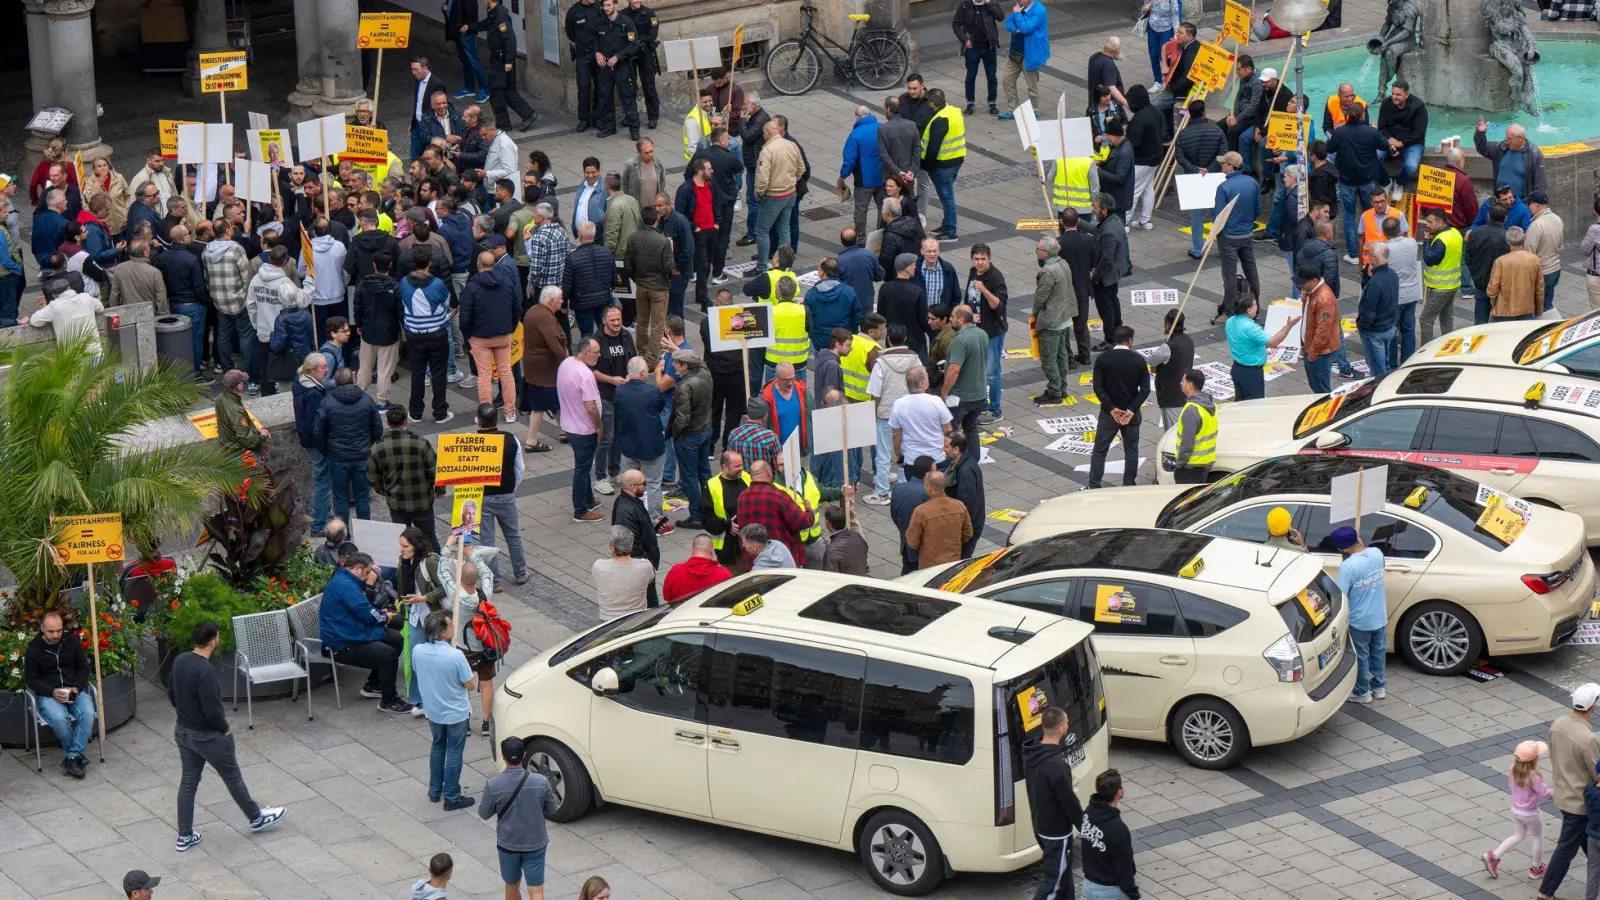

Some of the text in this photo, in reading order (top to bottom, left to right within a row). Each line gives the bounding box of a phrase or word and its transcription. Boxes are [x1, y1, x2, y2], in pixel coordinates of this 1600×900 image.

[352, 128, 374, 136] FAIRER
[455, 436, 485, 445] FAIRER
[443, 445, 498, 453] WETTBEWERB
[436, 465, 501, 473] SOZIALDUMPING
[68, 539, 106, 549] FAIRNESS
[743, 594, 762, 612] TAXI
